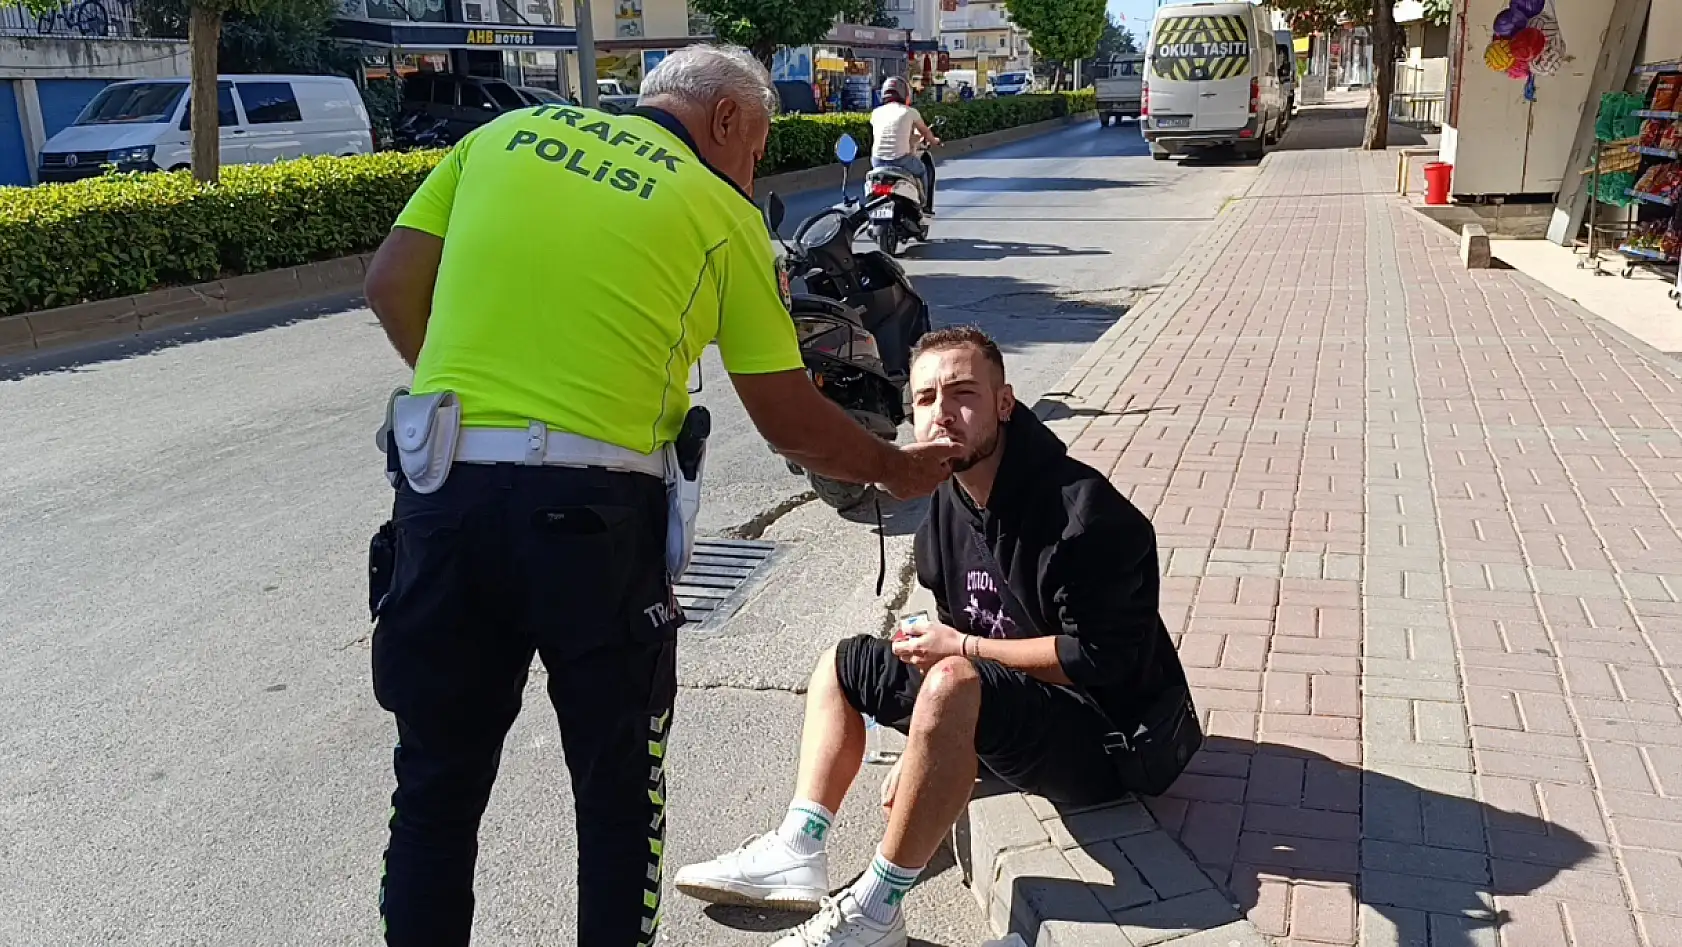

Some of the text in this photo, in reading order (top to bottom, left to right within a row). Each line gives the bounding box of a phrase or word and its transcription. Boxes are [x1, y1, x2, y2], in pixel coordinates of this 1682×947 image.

[466, 30, 534, 45] AHB MOTORS
[1160, 42, 1247, 58] OKUL TAŞITI
